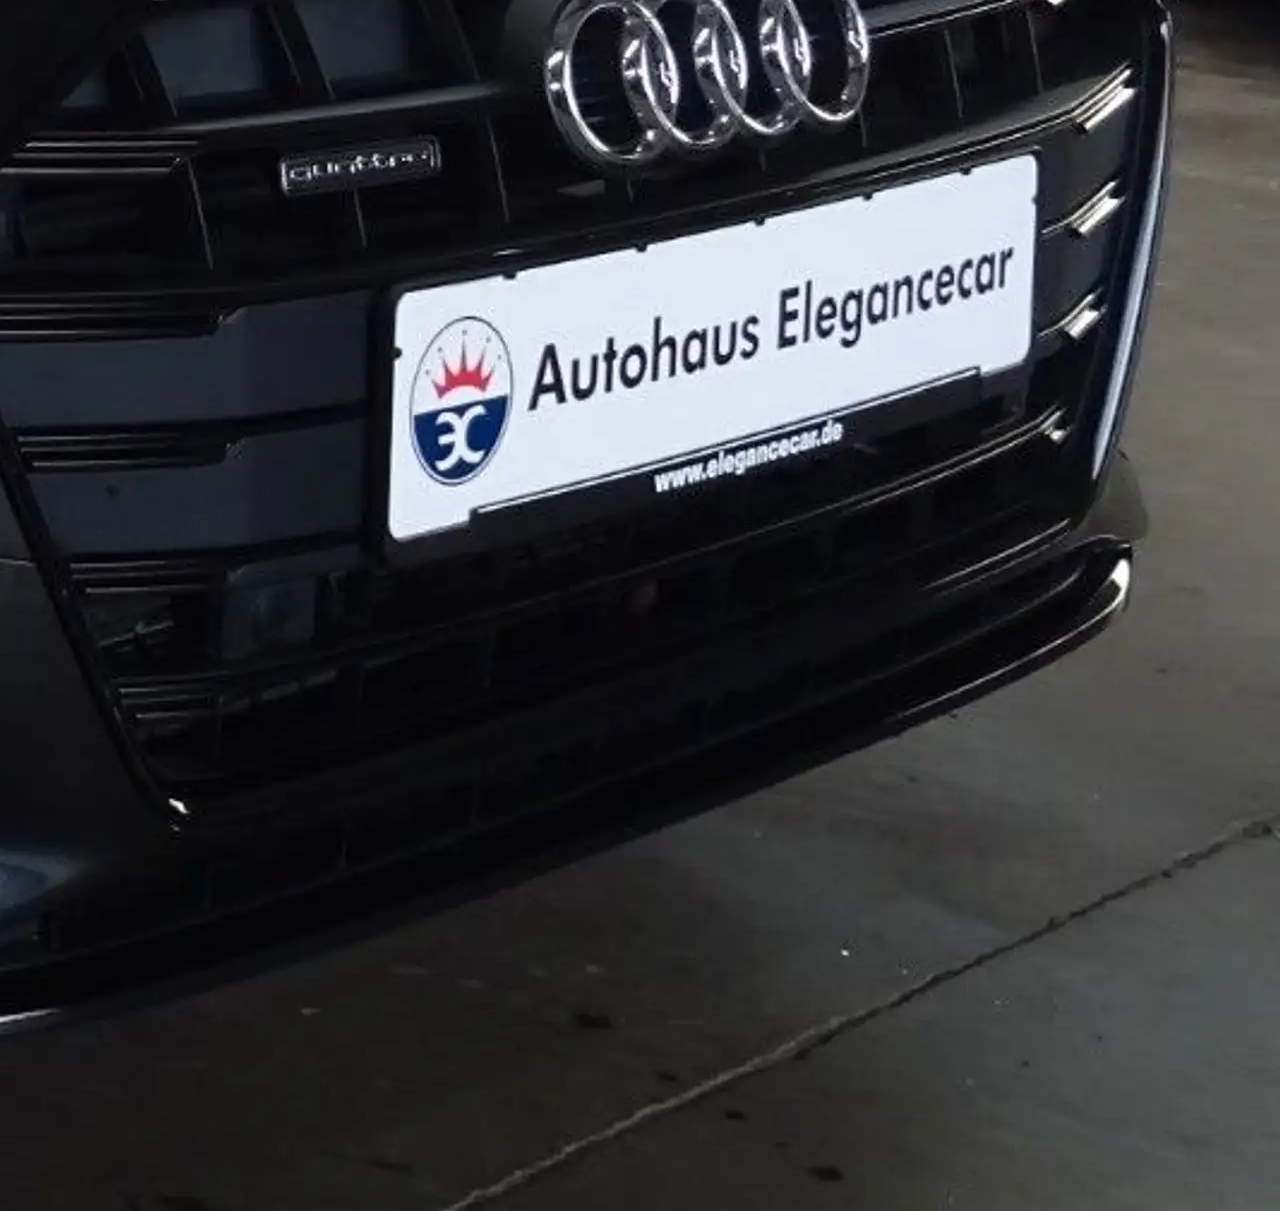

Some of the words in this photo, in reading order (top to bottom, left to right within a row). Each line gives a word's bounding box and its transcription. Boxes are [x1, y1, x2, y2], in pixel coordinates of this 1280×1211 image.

[528, 313, 759, 411] Autohaus
[776, 246, 1015, 351] Elegancecar
[653, 418, 845, 493] www.elegancecar.de
